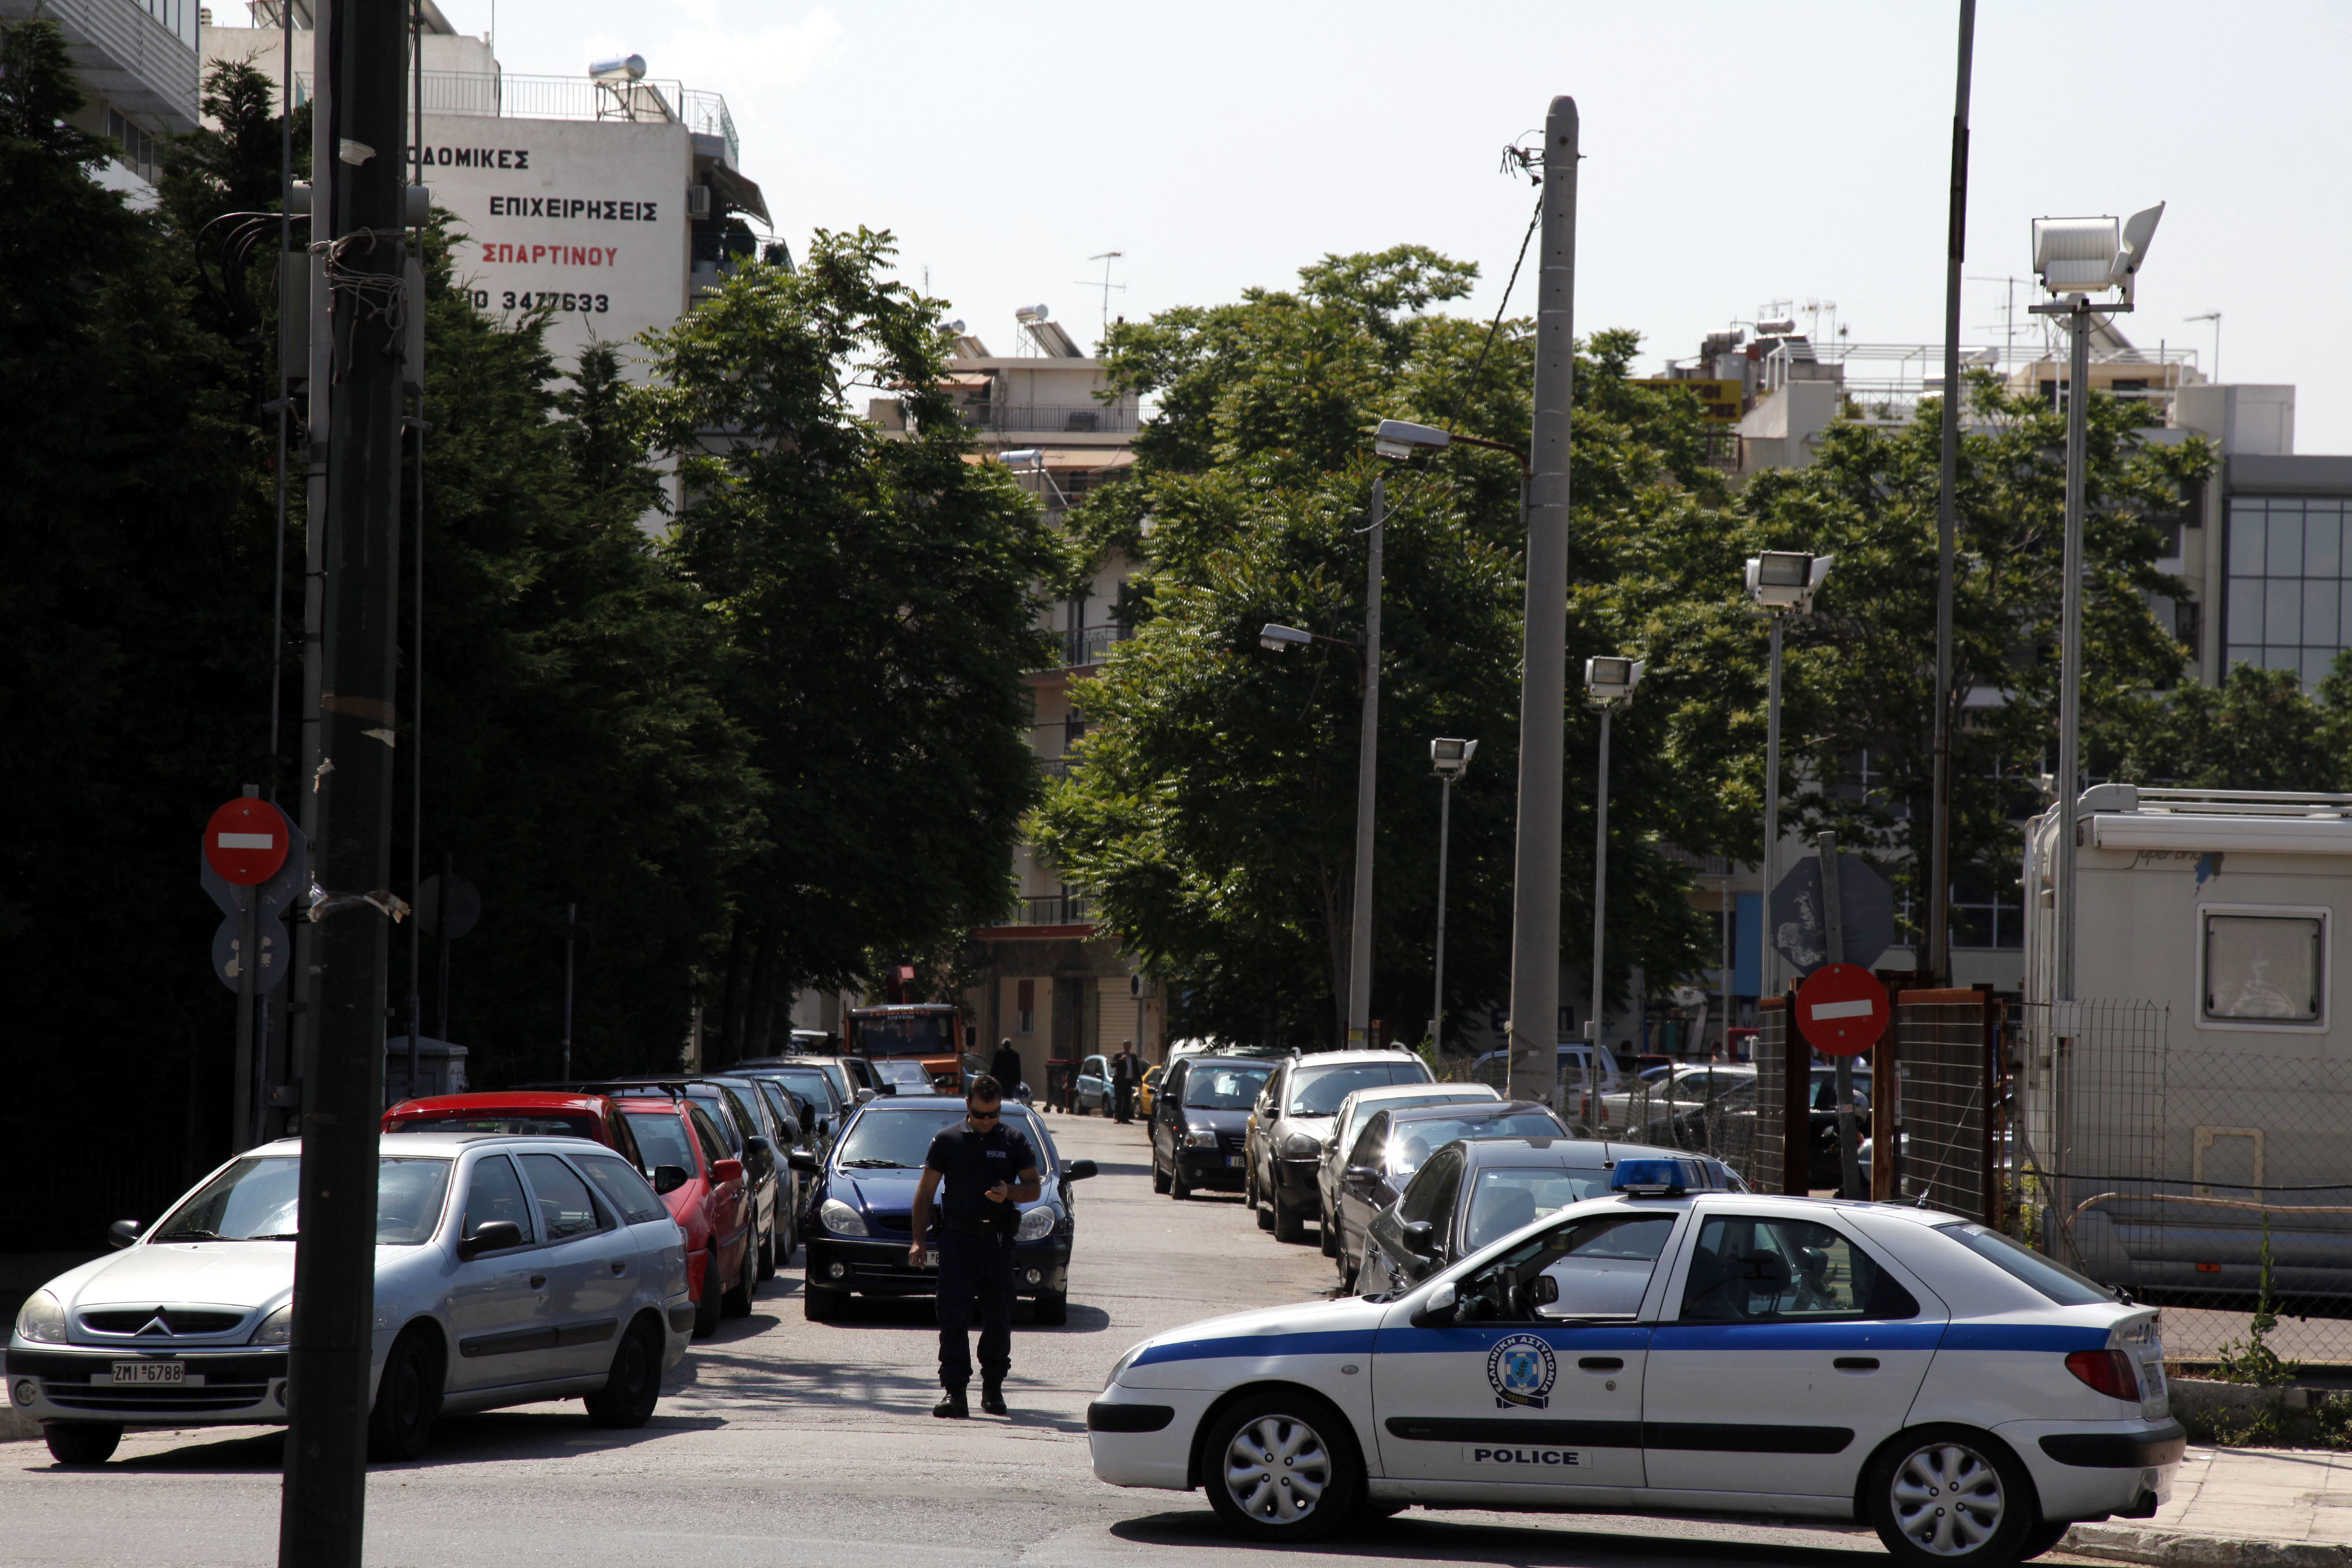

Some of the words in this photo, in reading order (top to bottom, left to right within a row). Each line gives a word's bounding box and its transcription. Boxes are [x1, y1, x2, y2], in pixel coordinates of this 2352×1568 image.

[489, 196, 657, 221] ΕΠΙΧΕΙΡΗΣΕΙΣ
[482, 243, 618, 266] ΣΠΑΡΤΙΝΟΥ
[502, 291, 609, 313] 3477633
[1489, 1337, 1516, 1393] ΕΛΛΗΝΙΚΗ
[1520, 1336, 1555, 1393] ΑΣΤΥΝΟΜΙΑ
[1474, 1448, 1580, 1466] POLICE
